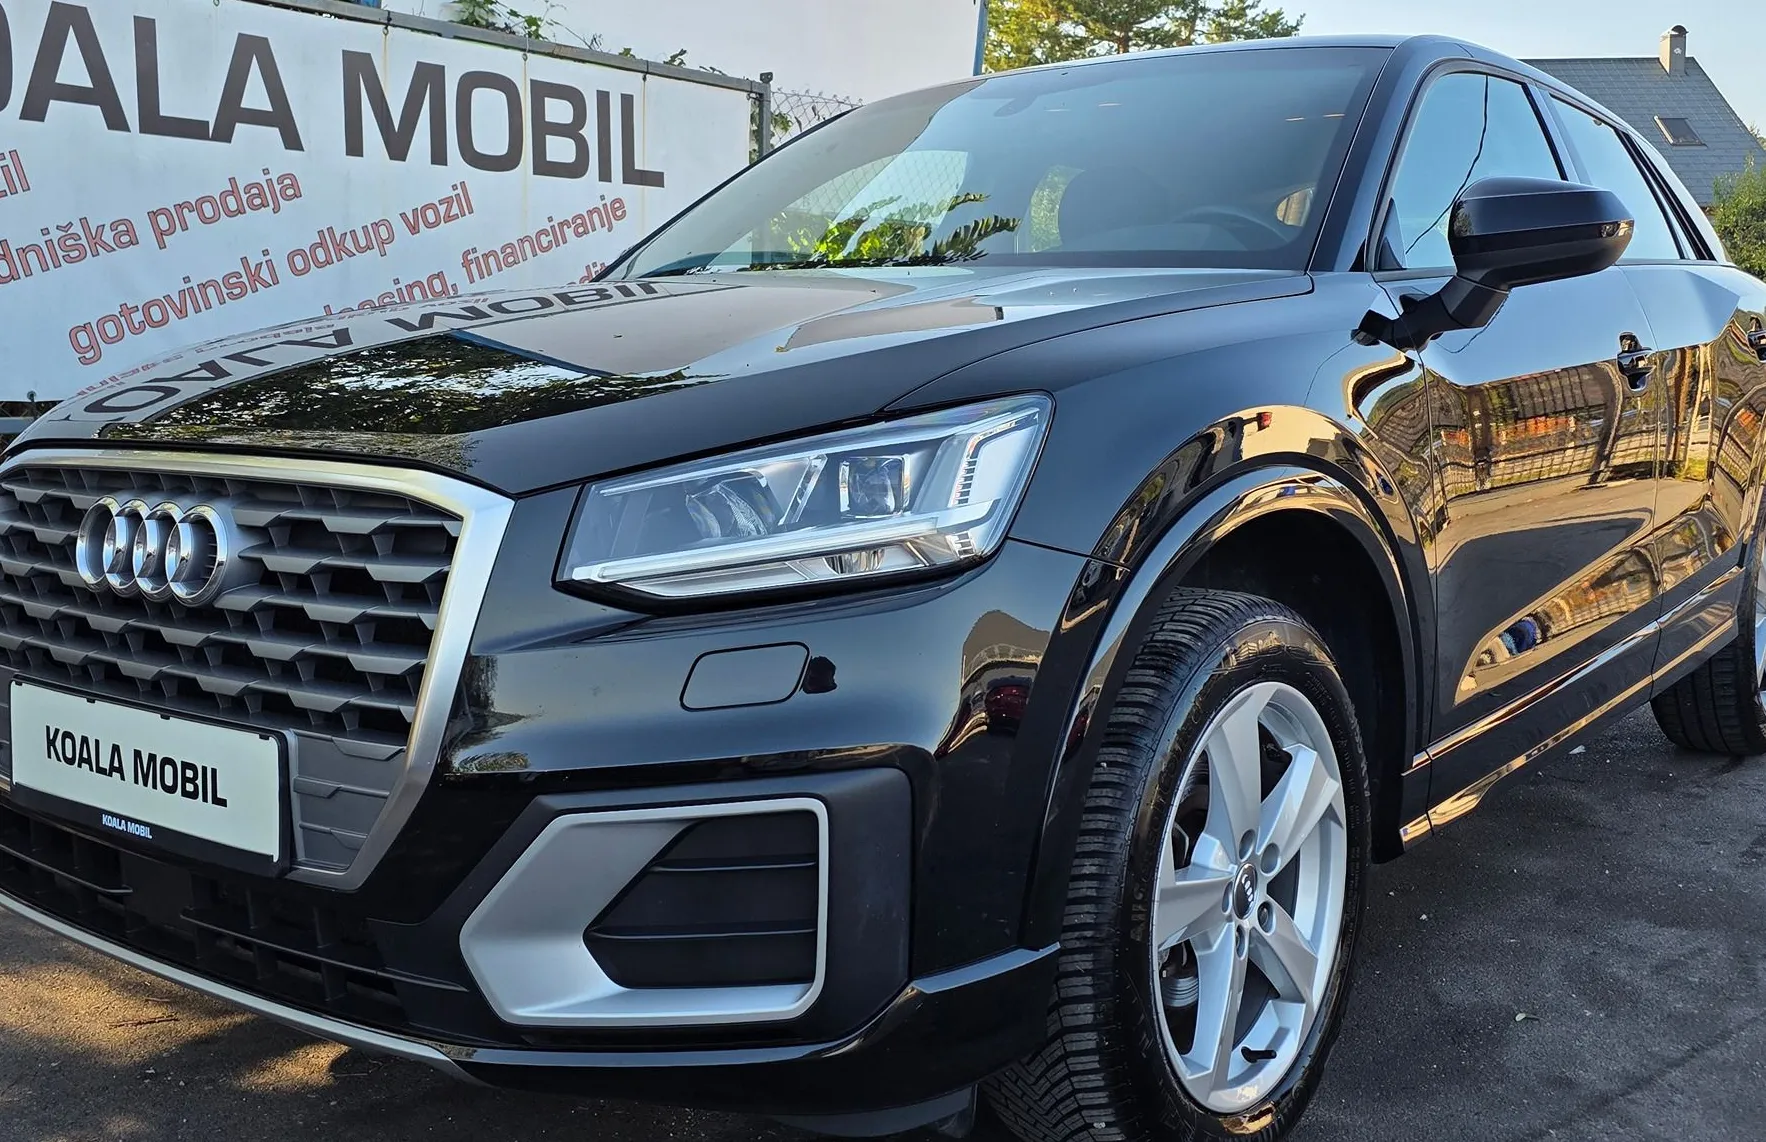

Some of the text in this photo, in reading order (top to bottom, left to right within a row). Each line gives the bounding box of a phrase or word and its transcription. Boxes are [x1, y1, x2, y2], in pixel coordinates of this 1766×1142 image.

[0, 1, 665, 188] ALA MOBIL
[147, 168, 302, 249] prodaja
[462, 195, 627, 284] financiranje
[68, 249, 279, 365] gotovinski
[287, 226, 395, 277] odkup
[399, 181, 474, 236] vozil
[45, 725, 228, 808] KOALA MOBIL
[102, 813, 153, 839] KOALA MOBIL
